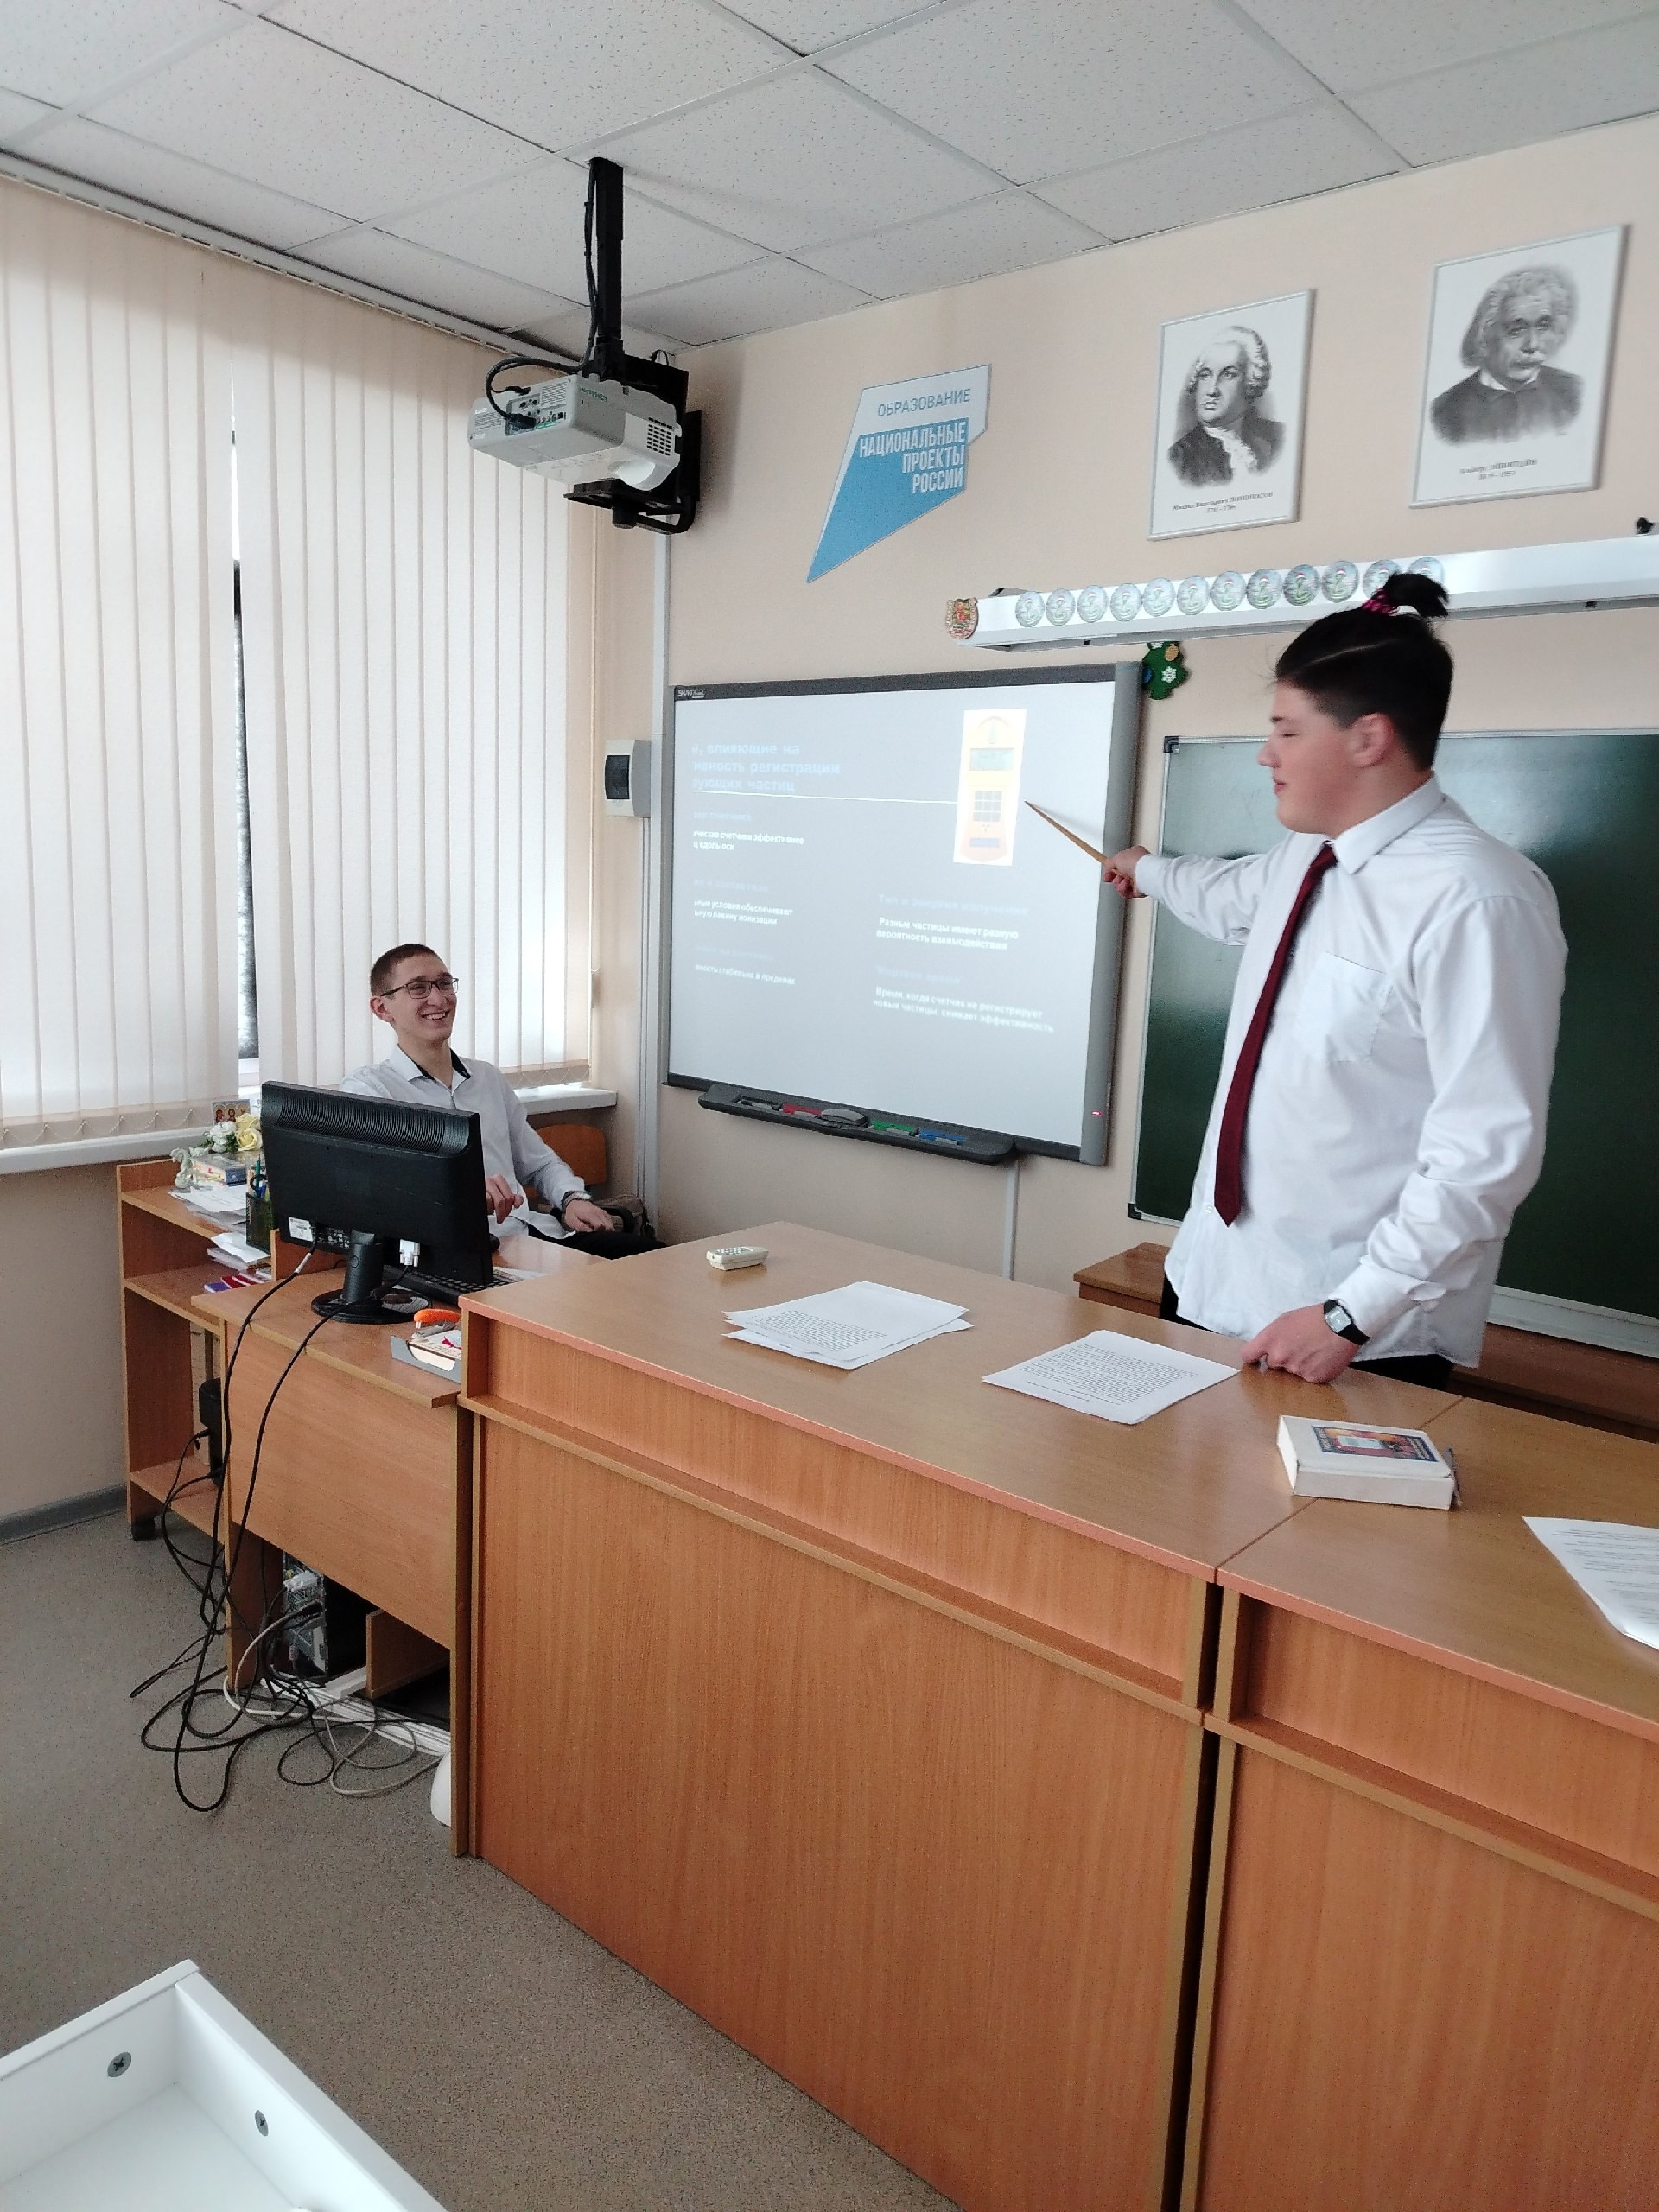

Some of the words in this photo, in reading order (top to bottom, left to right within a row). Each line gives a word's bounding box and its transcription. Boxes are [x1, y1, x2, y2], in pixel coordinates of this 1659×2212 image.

[877, 388, 972, 417] ОБРАЗОВАНИЕ
[859, 422, 967, 458] НАЦИОНАЛЬНЫЕ
[902, 445, 965, 474] ПРОЕКТЫ
[912, 467, 963, 494] РОССИИ
[707, 744, 778, 756] влияющие
[782, 745, 801, 755] на
[750, 762, 841, 777] регистрации
[747, 779, 796, 793] частиц
